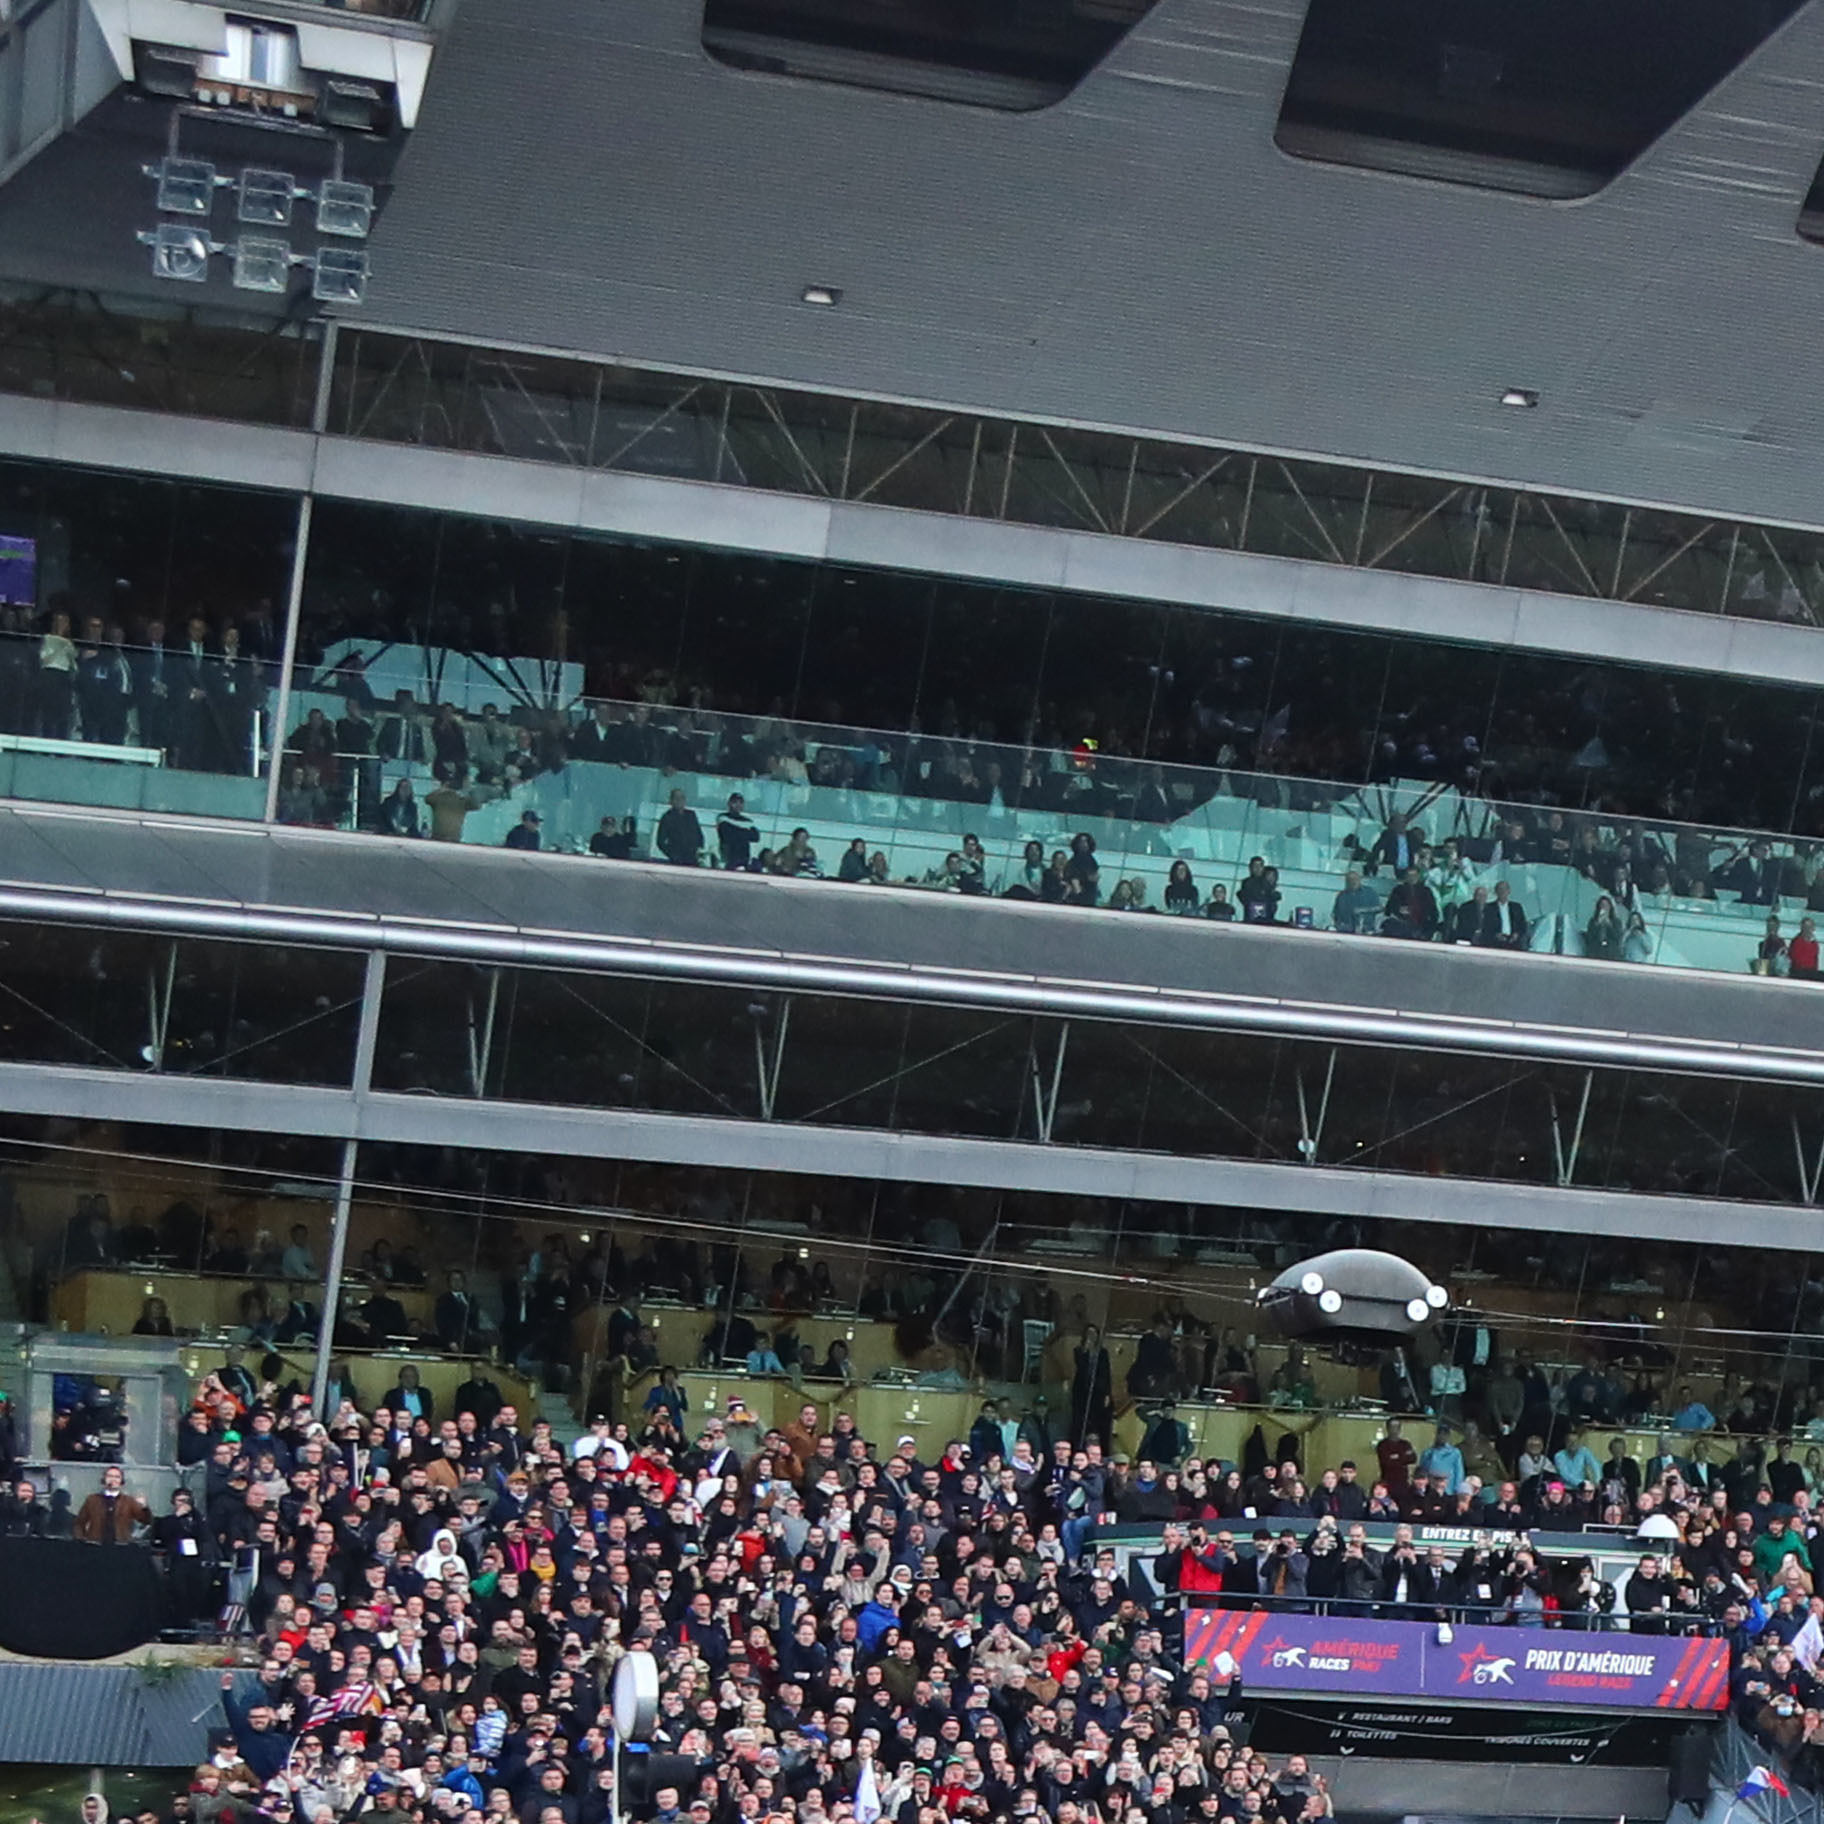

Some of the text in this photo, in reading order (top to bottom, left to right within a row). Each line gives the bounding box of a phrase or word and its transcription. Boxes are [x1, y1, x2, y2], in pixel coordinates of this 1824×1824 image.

[1421, 1527, 1470, 1541] ENTREZ
[1309, 1656, 1350, 1671] RACES
[1525, 1649, 1655, 1676] PRIX D'AMÉRIQUE
[1352, 1712, 1417, 1723] RESTAURANT
